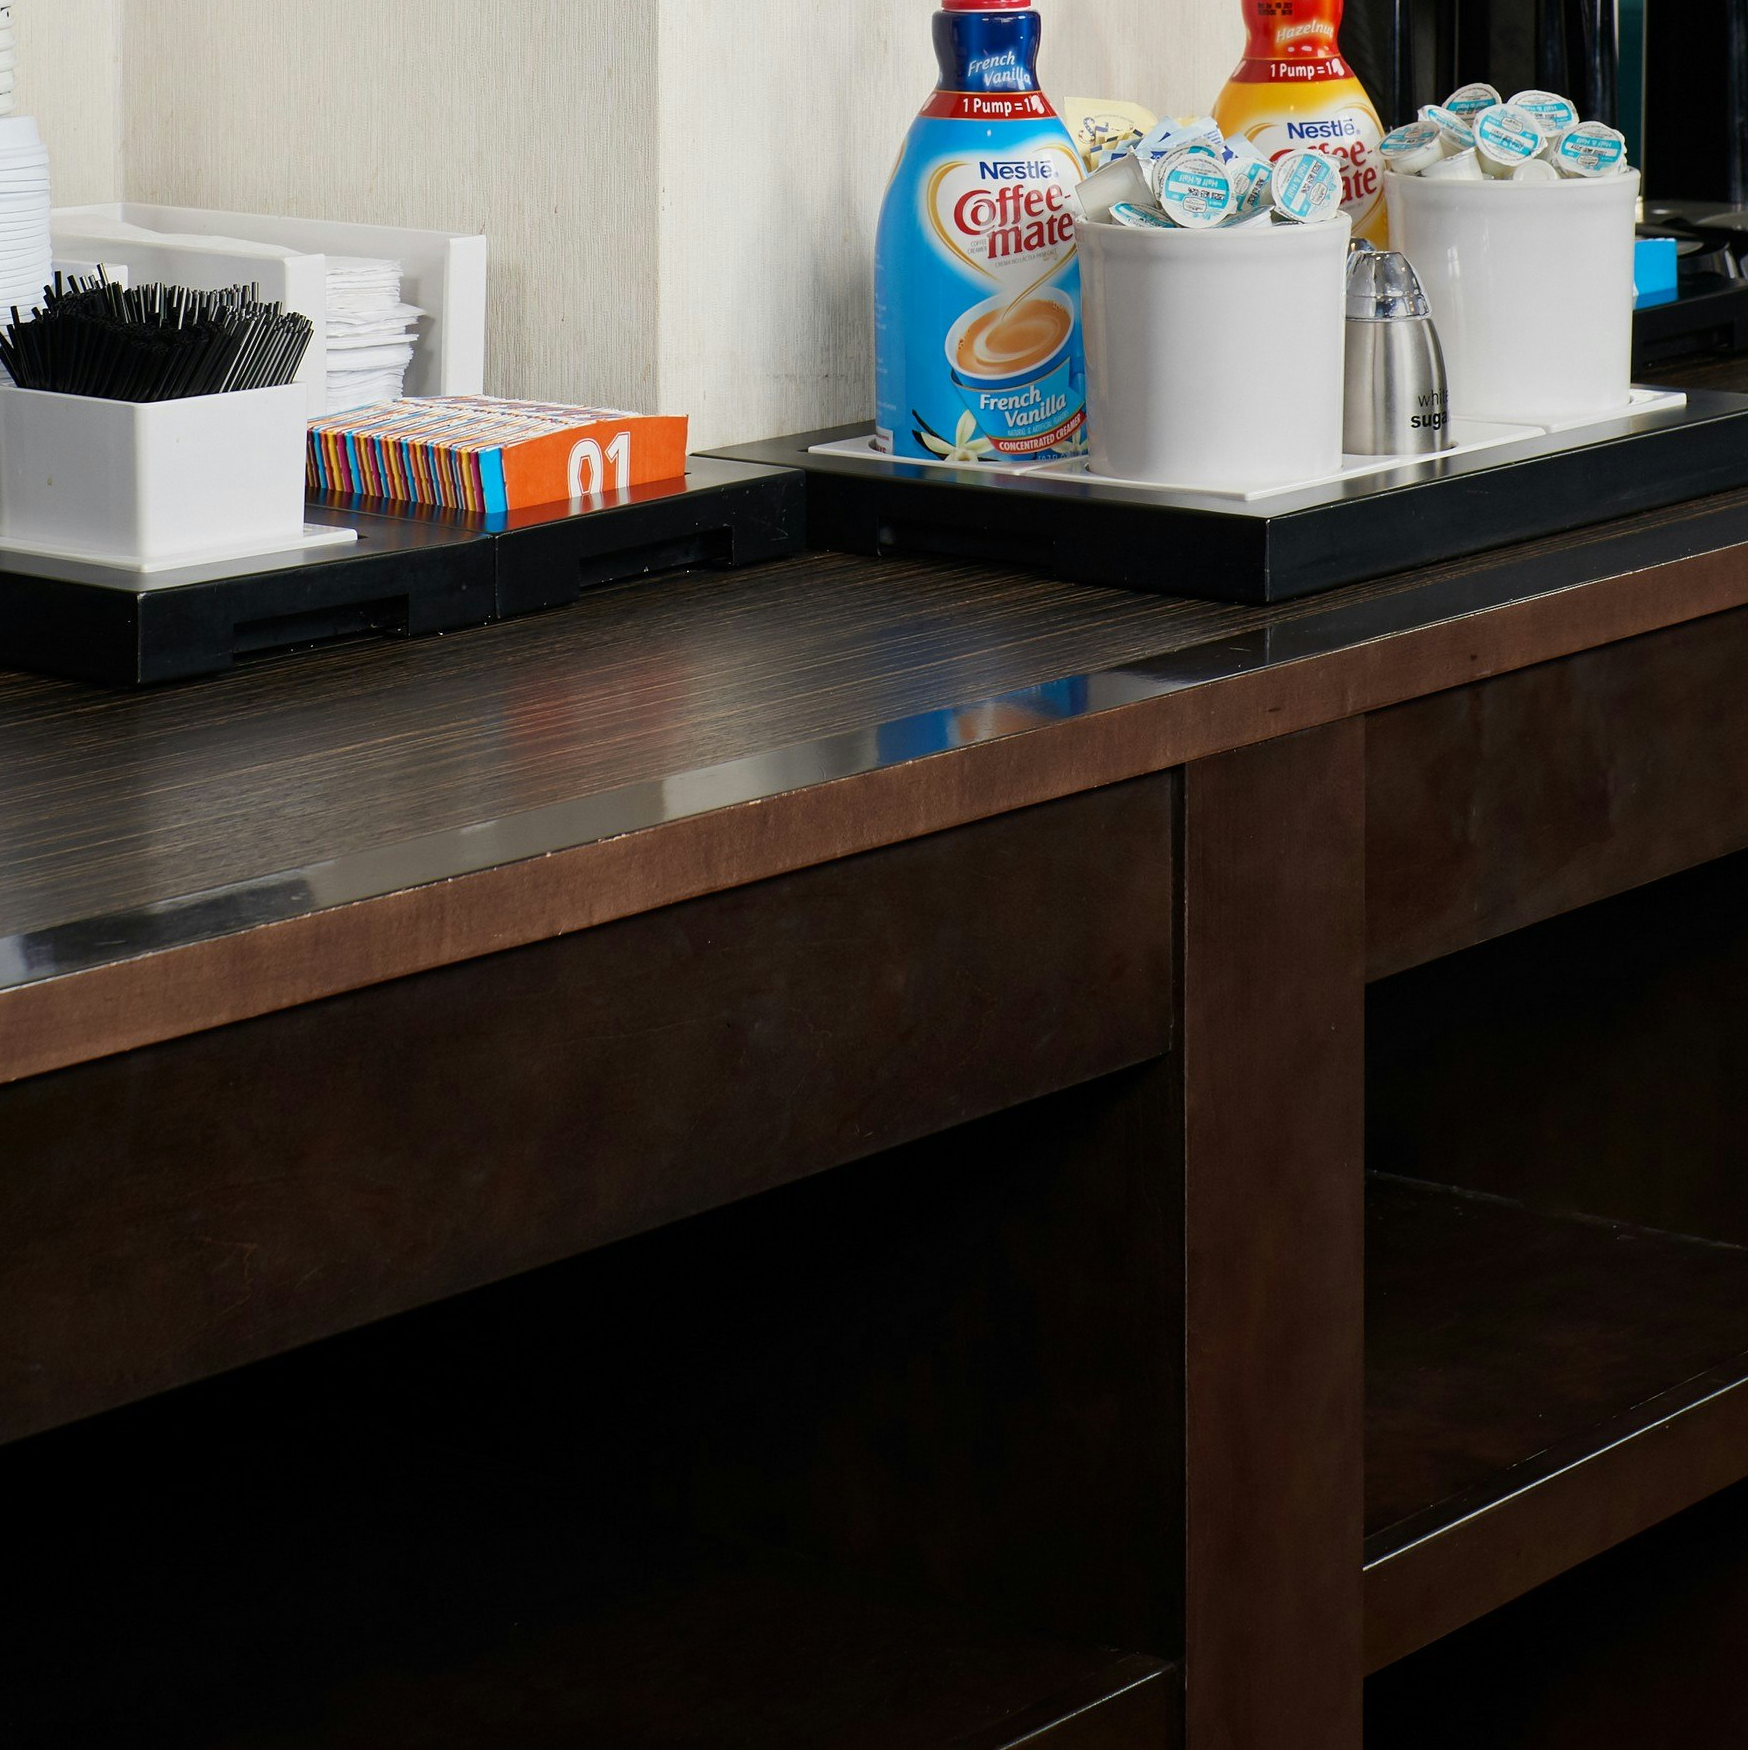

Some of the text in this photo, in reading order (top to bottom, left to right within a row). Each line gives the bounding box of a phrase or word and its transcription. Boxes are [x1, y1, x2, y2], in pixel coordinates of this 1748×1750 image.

[968, 51, 1015, 77] French
[1270, 63, 1276, 78] 1
[1279, 62, 1315, 80] Pump
[984, 67, 1031, 87] Vanilla
[963, 98, 969, 113] 1
[973, 97, 1012, 117] Pump
[1340, 166, 1377, 205] ate
[987, 212, 1074, 259] mate
[979, 385, 1042, 410] French
[1004, 393, 1067, 428] Vanilla
[1410, 411, 1448, 430] suga
[999, 412, 1082, 451] CONCENTRATED CREAMER
